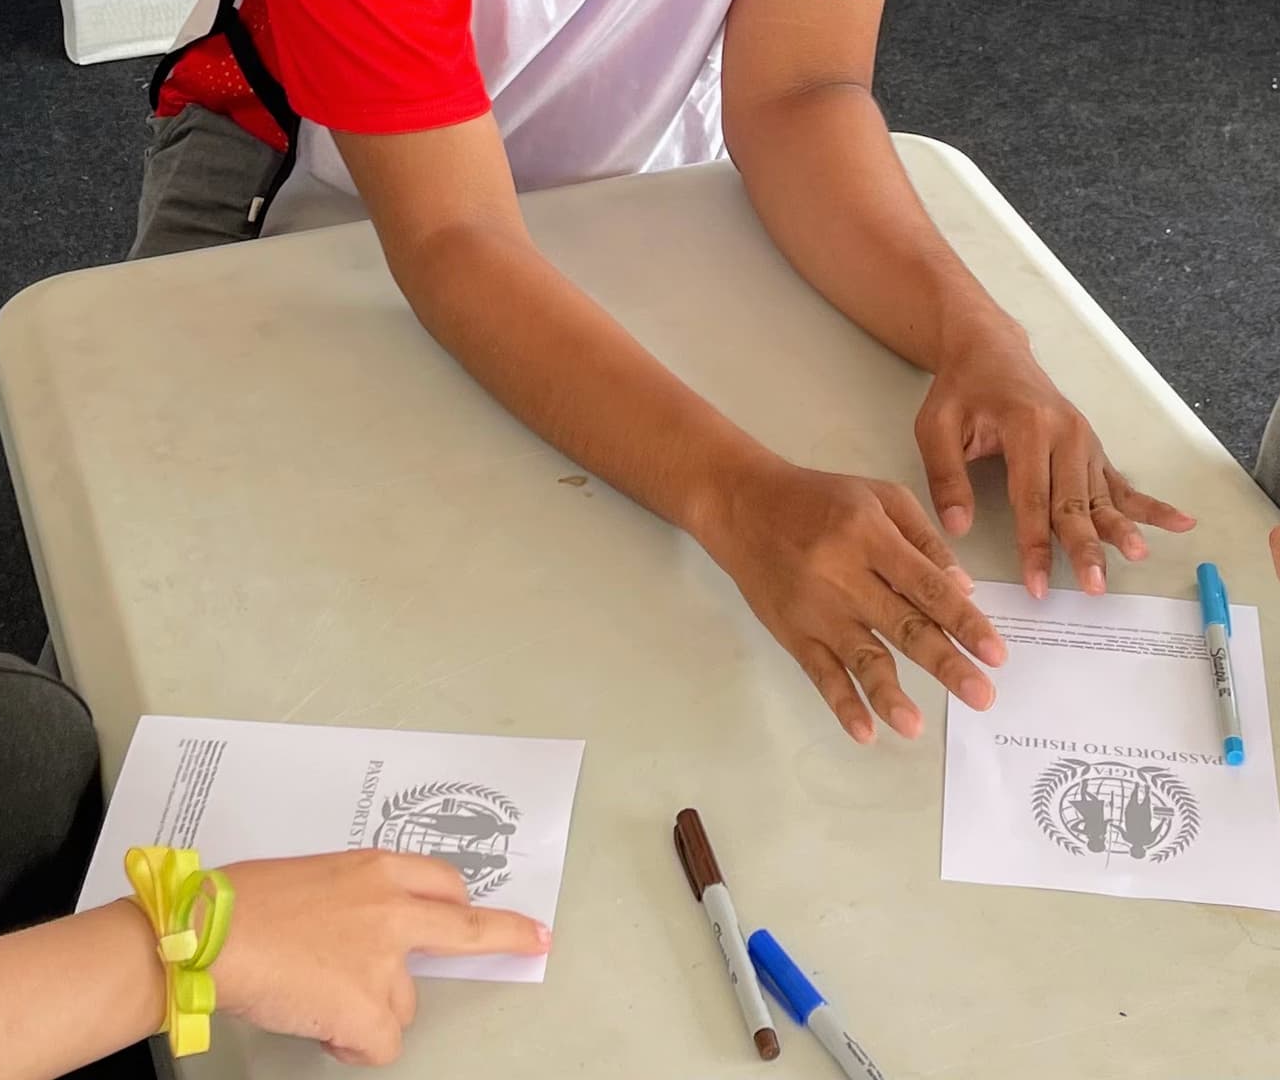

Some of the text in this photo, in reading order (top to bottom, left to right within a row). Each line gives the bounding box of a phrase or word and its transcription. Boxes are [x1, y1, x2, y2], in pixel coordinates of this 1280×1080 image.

[995, 735, 1223, 766] PASSPORTS TO FISHING
[1094, 767, 1135, 777] IGFA
[350, 760, 384, 836] PASSPORTS
